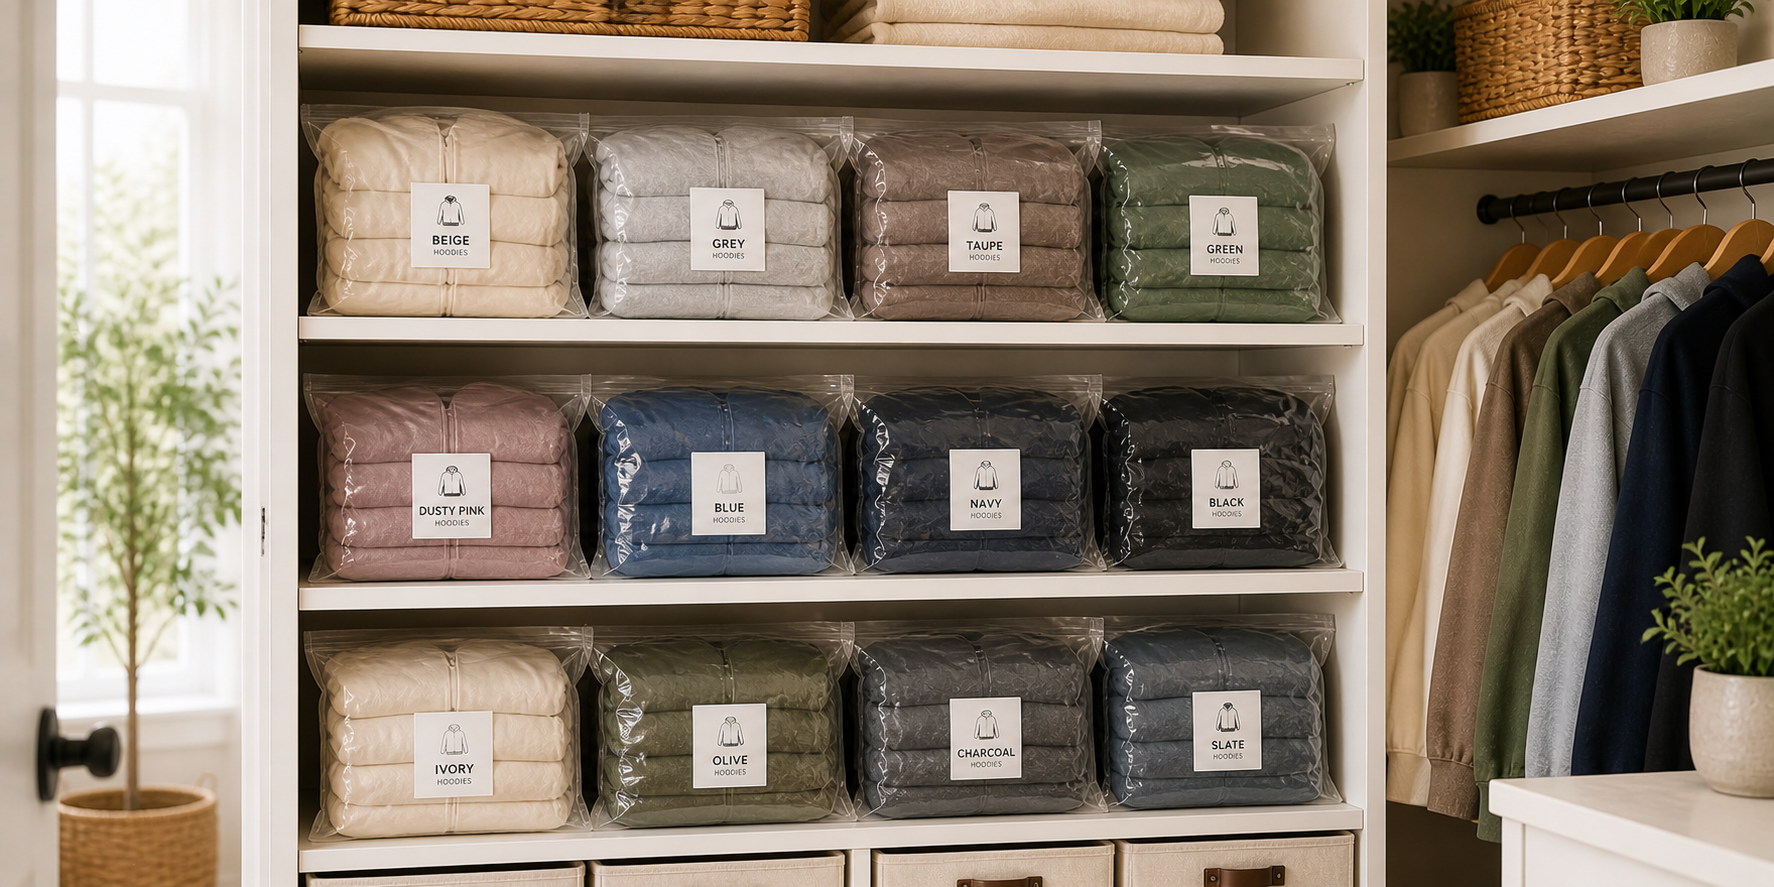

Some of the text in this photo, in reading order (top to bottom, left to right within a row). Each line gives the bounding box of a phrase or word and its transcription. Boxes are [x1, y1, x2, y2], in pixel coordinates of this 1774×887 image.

[433, 235, 470, 246] BEIGE
[711, 239, 746, 249] GREY
[965, 240, 1003, 250] TAUPE
[434, 249, 469, 257] HOODIES
[1206, 244, 1243, 254] GREEN
[712, 251, 745, 260] HOODIES
[969, 253, 1000, 261] HOODIES
[1210, 257, 1240, 265] HOODIES
[970, 499, 1003, 509] NAVY
[1209, 497, 1244, 507] BLACK
[418, 505, 486, 516] DUSTY PINK
[714, 502, 745, 513] BLUE
[970, 512, 1002, 520] HOODIES
[1211, 510, 1242, 518] HOODIES
[435, 518, 470, 527] HOODIES
[712, 516, 745, 524] HOODIES
[1211, 740, 1245, 750] SLATE
[957, 748, 1016, 758] CHARCOAL
[1212, 752, 1244, 760] HOODIES
[712, 755, 748, 766] OLIVE
[970, 761, 1003, 769] HOODIES
[435, 763, 474, 774] IVORY
[714, 768, 746, 777] HOODIES
[436, 777, 471, 786] HOODIES
